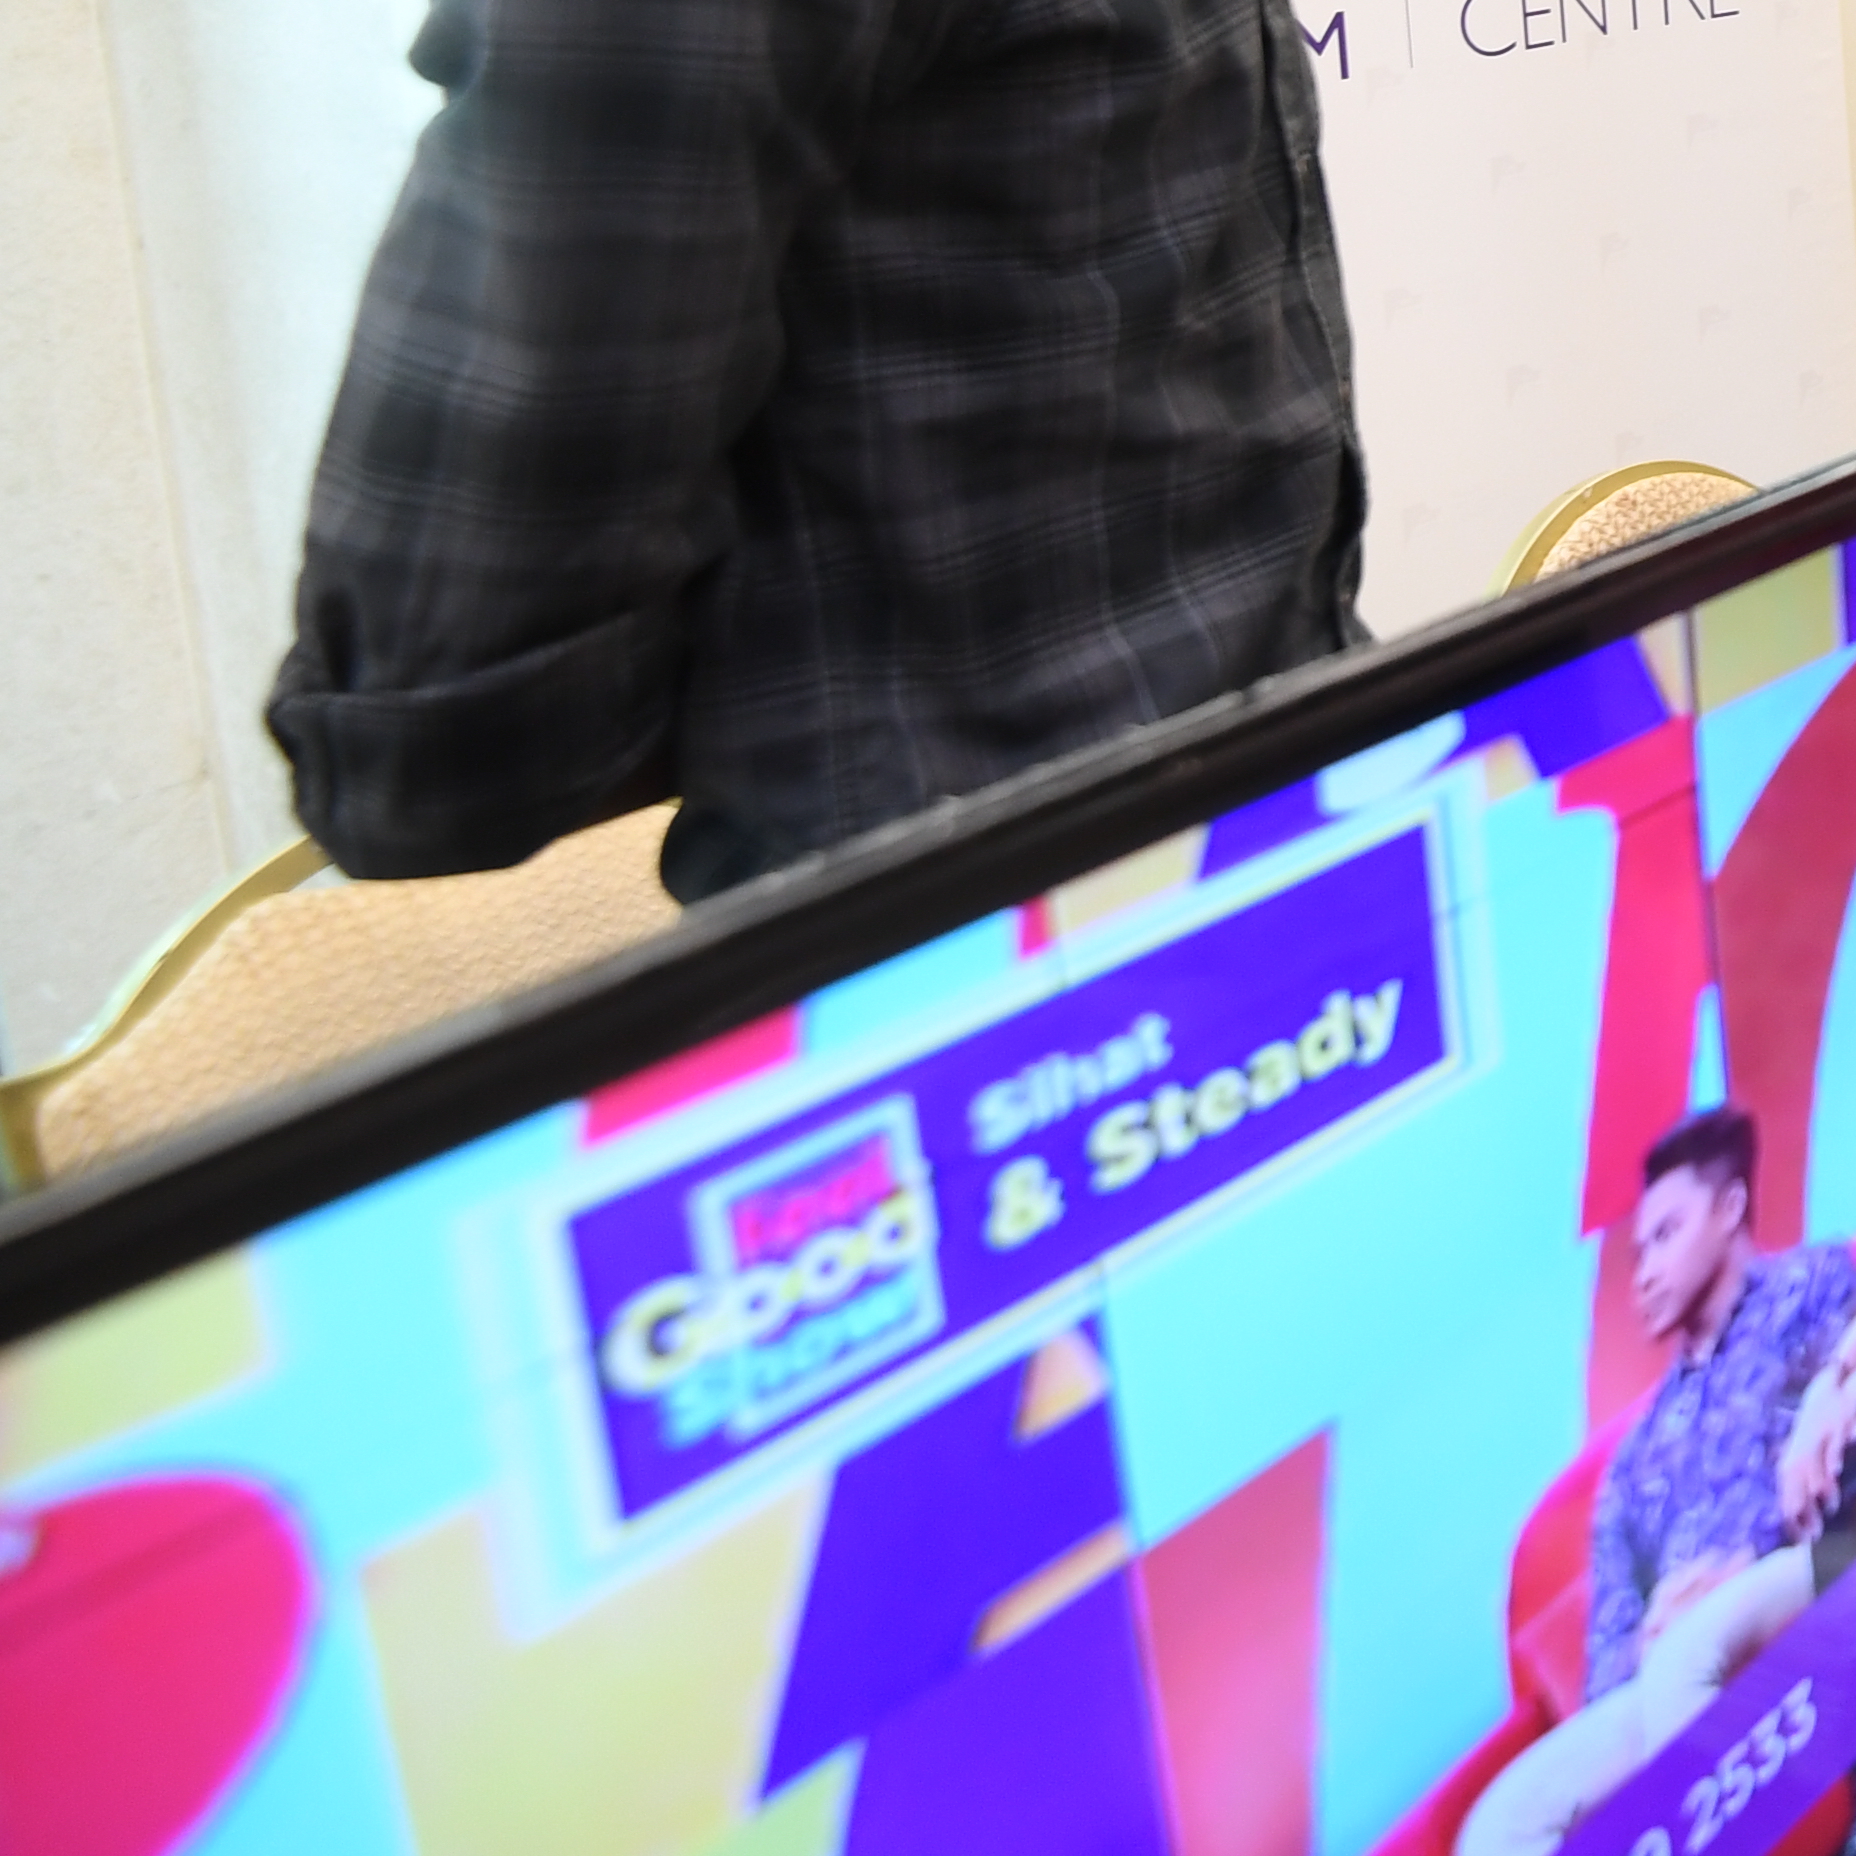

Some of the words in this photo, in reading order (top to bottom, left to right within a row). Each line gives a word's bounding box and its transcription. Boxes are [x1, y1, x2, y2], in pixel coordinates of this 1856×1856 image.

[967, 1010, 1173, 1154] Sihat
[980, 1158, 1064, 1252] &
[1084, 978, 1402, 1193] Steady
[602, 1189, 926, 1394] Good
[1681, 1676, 1818, 1853] 2533
